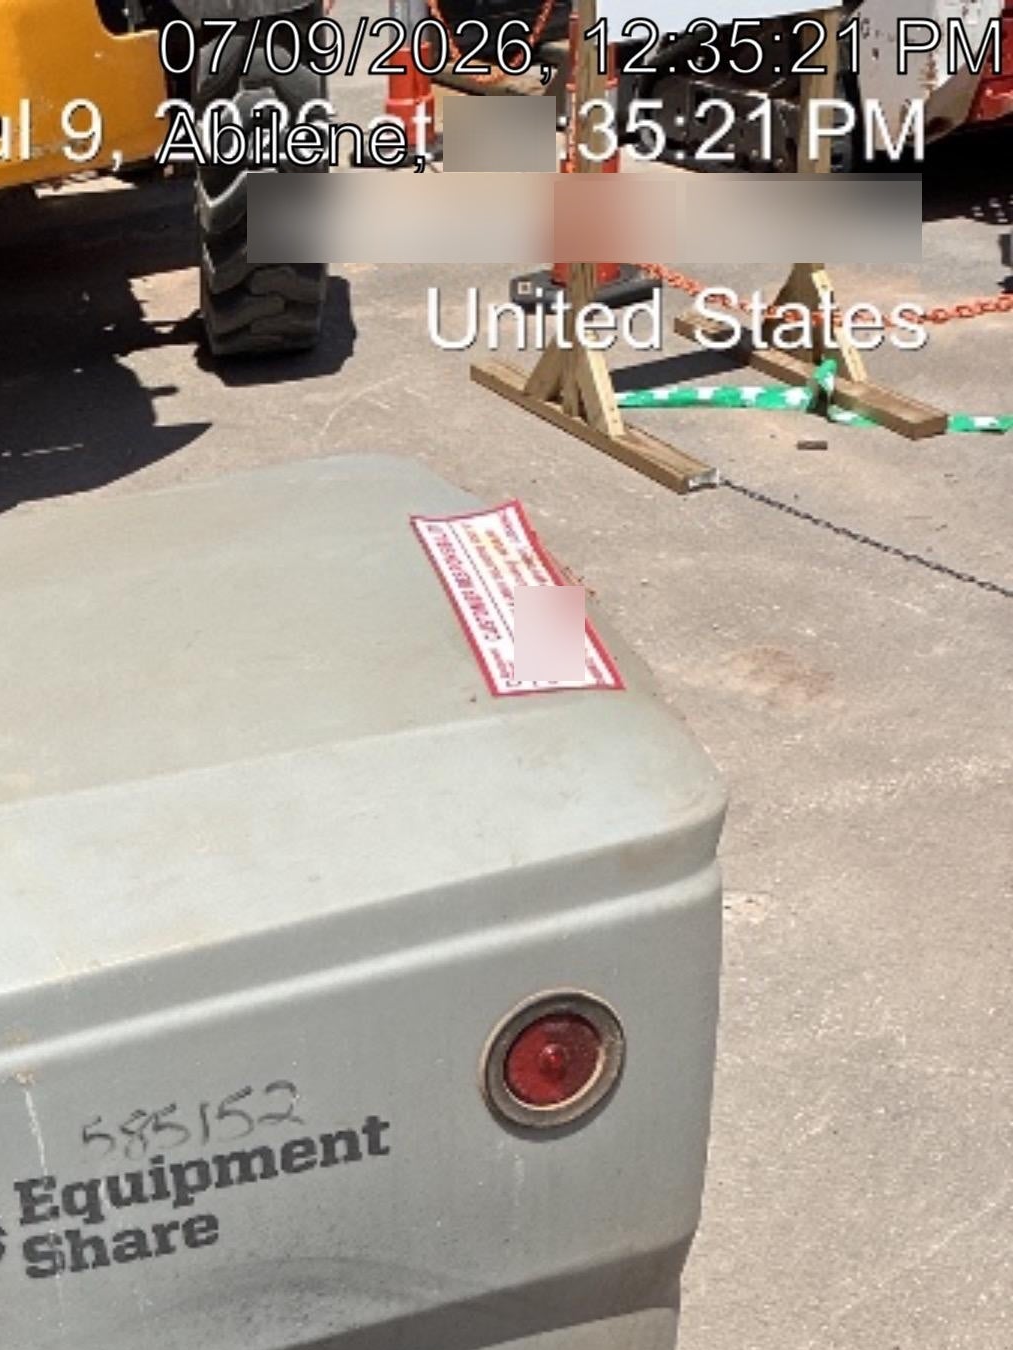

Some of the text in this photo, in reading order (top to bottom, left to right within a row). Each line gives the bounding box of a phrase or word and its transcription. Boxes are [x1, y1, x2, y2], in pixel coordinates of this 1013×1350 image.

[81, 1079, 305, 1161] 585152
[14, 1115, 391, 1225] Equipment
[22, 1213, 220, 1279] Share
